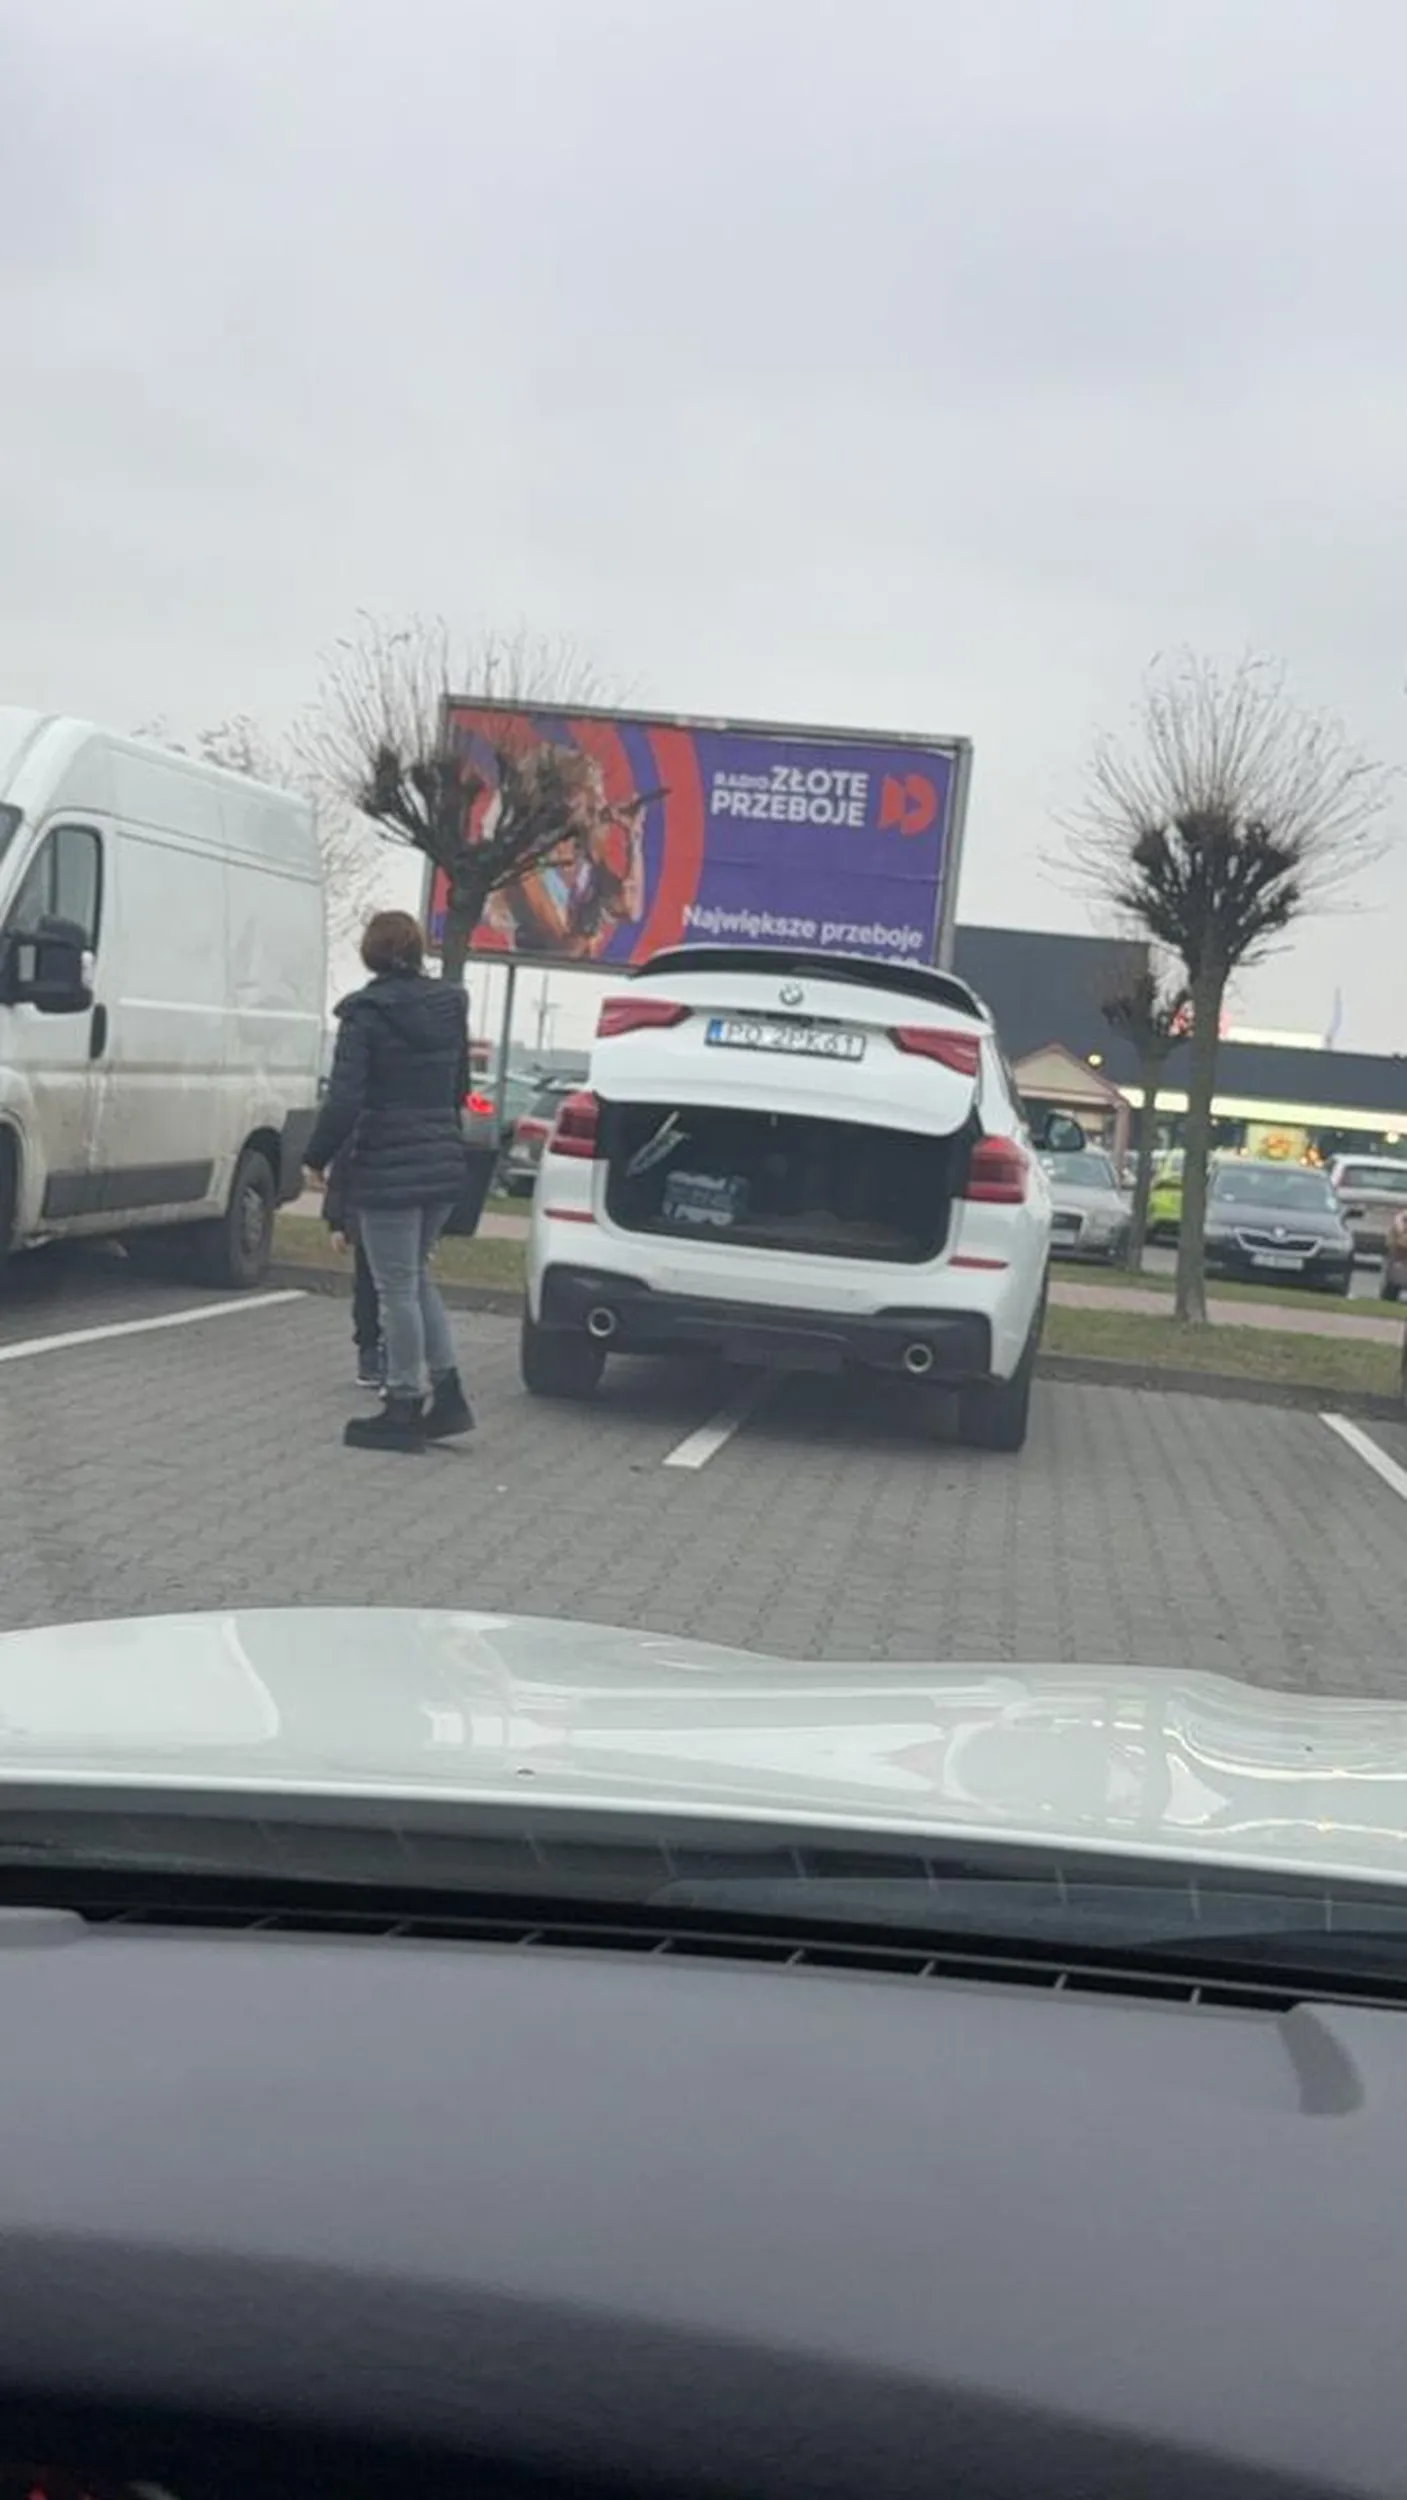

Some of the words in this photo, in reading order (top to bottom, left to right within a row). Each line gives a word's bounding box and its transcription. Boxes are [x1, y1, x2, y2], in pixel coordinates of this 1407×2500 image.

[713, 771, 770, 790] RADIO
[770, 765, 869, 798] ZŁOTE
[711, 790, 867, 827] PRZEBOJE
[682, 903, 815, 941] Największe
[820, 920, 924, 952] przeboje
